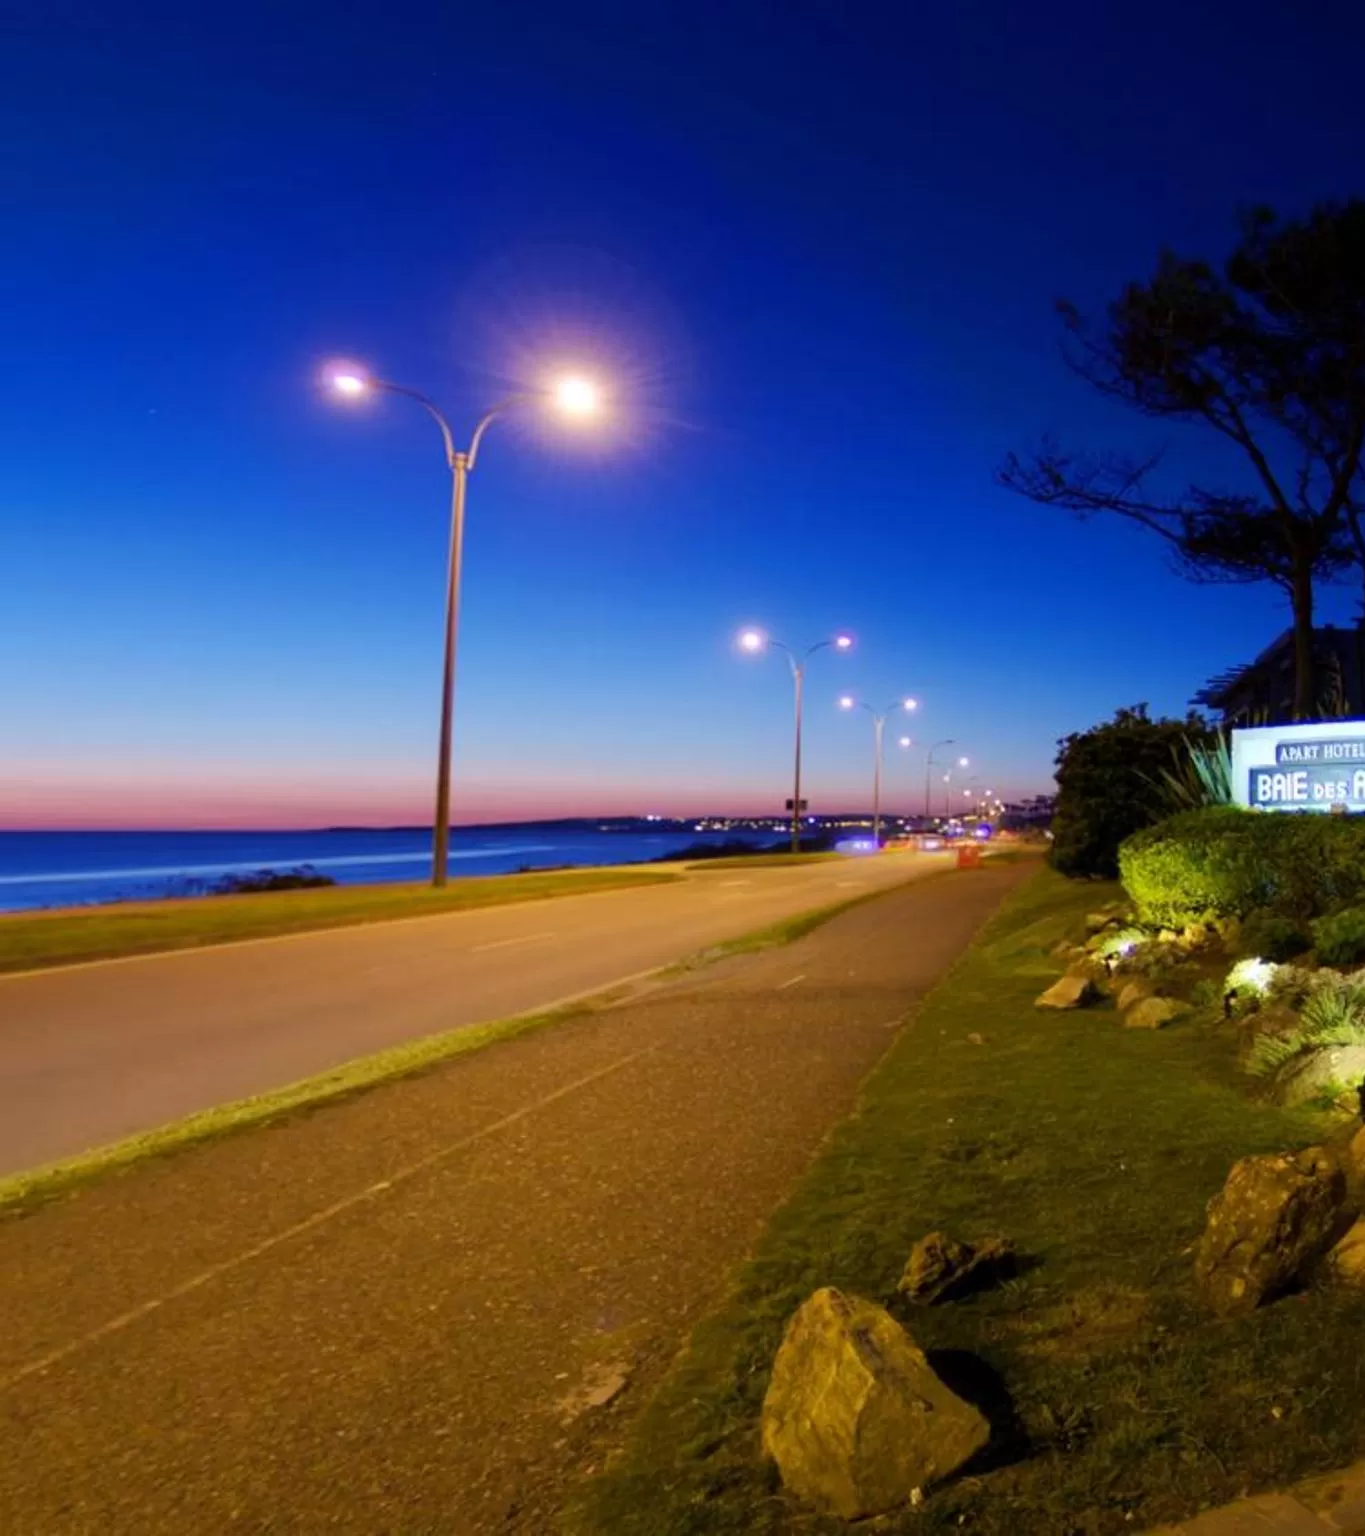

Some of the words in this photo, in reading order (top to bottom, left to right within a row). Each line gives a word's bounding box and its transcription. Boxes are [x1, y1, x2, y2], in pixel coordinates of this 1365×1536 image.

[1280, 745, 1319, 761] APART
[1323, 742, 1365, 759] HOTEL
[1257, 771, 1308, 802] BAIE
[1313, 782, 1347, 800] DES
